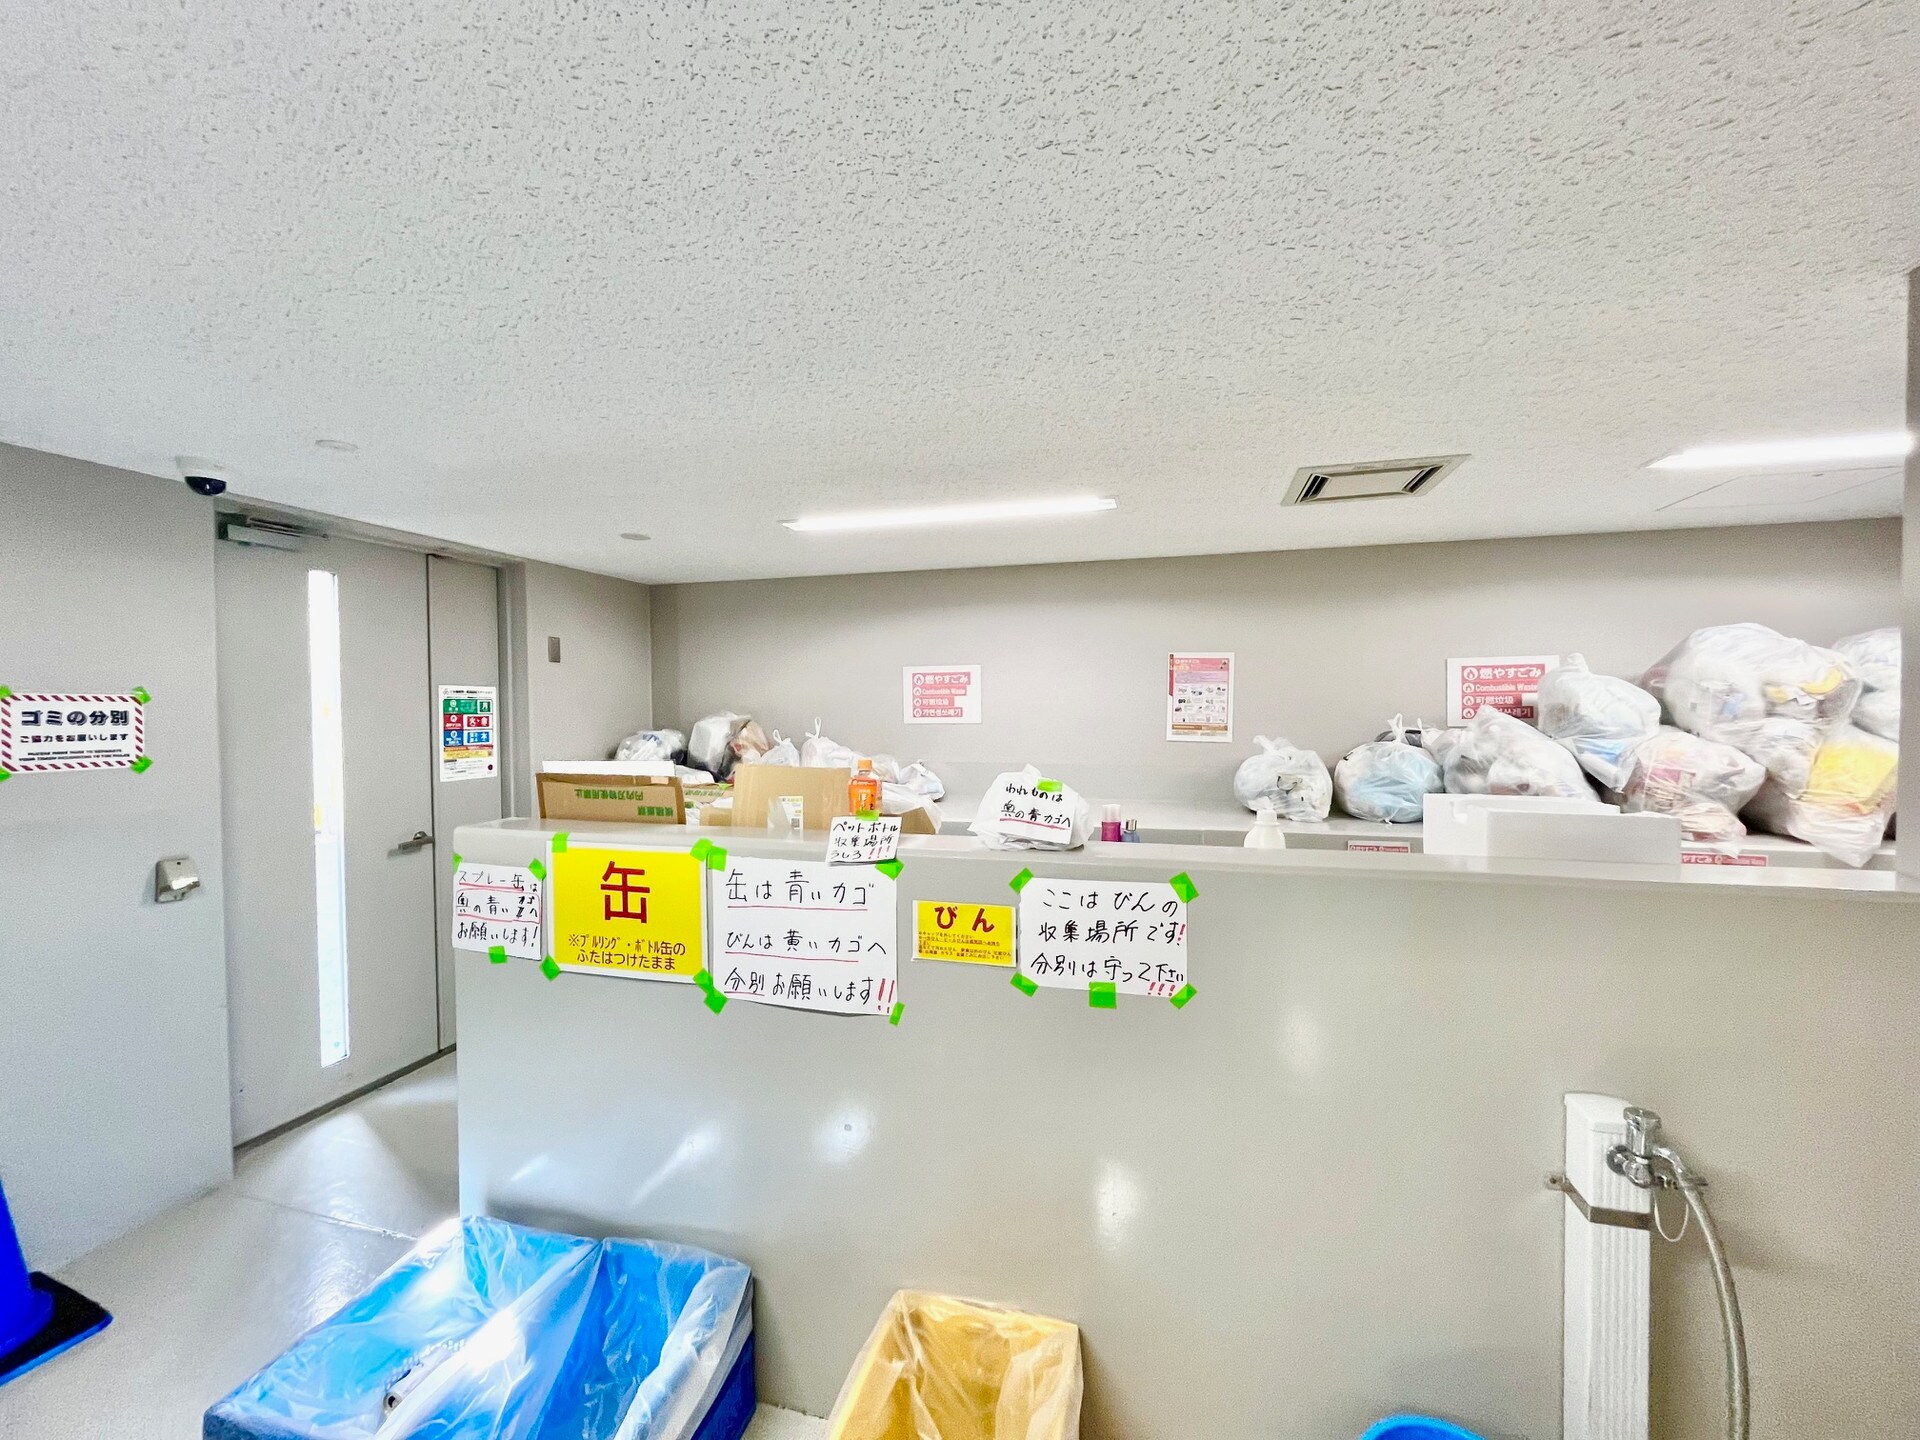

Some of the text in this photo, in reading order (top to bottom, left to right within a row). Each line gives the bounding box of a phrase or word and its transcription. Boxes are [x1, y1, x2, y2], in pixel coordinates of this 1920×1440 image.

[924, 674, 969, 685] 燃やすごみ
[1479, 667, 1542, 679] 燃やすごみ
[1475, 684, 1516, 692] Combustible
[21, 710, 130, 726] ゴミの分別
[1005, 783, 1063, 801] われものは
[833, 821, 899, 833] ペットボトル
[834, 833, 893, 847] 収集場所
[458, 870, 538, 892] スプレー缶は
[725, 868, 875, 905] 缶は青いカゴ
[600, 860, 650, 924] 缶
[1043, 888, 1178, 917] ここはびんの
[934, 905, 995, 933] びん
[726, 928, 886, 955] びんは黄いカゴへ
[577, 950, 676, 970] ふたはつけたまま
[1030, 953, 1184, 982] 分別は守って下さい
